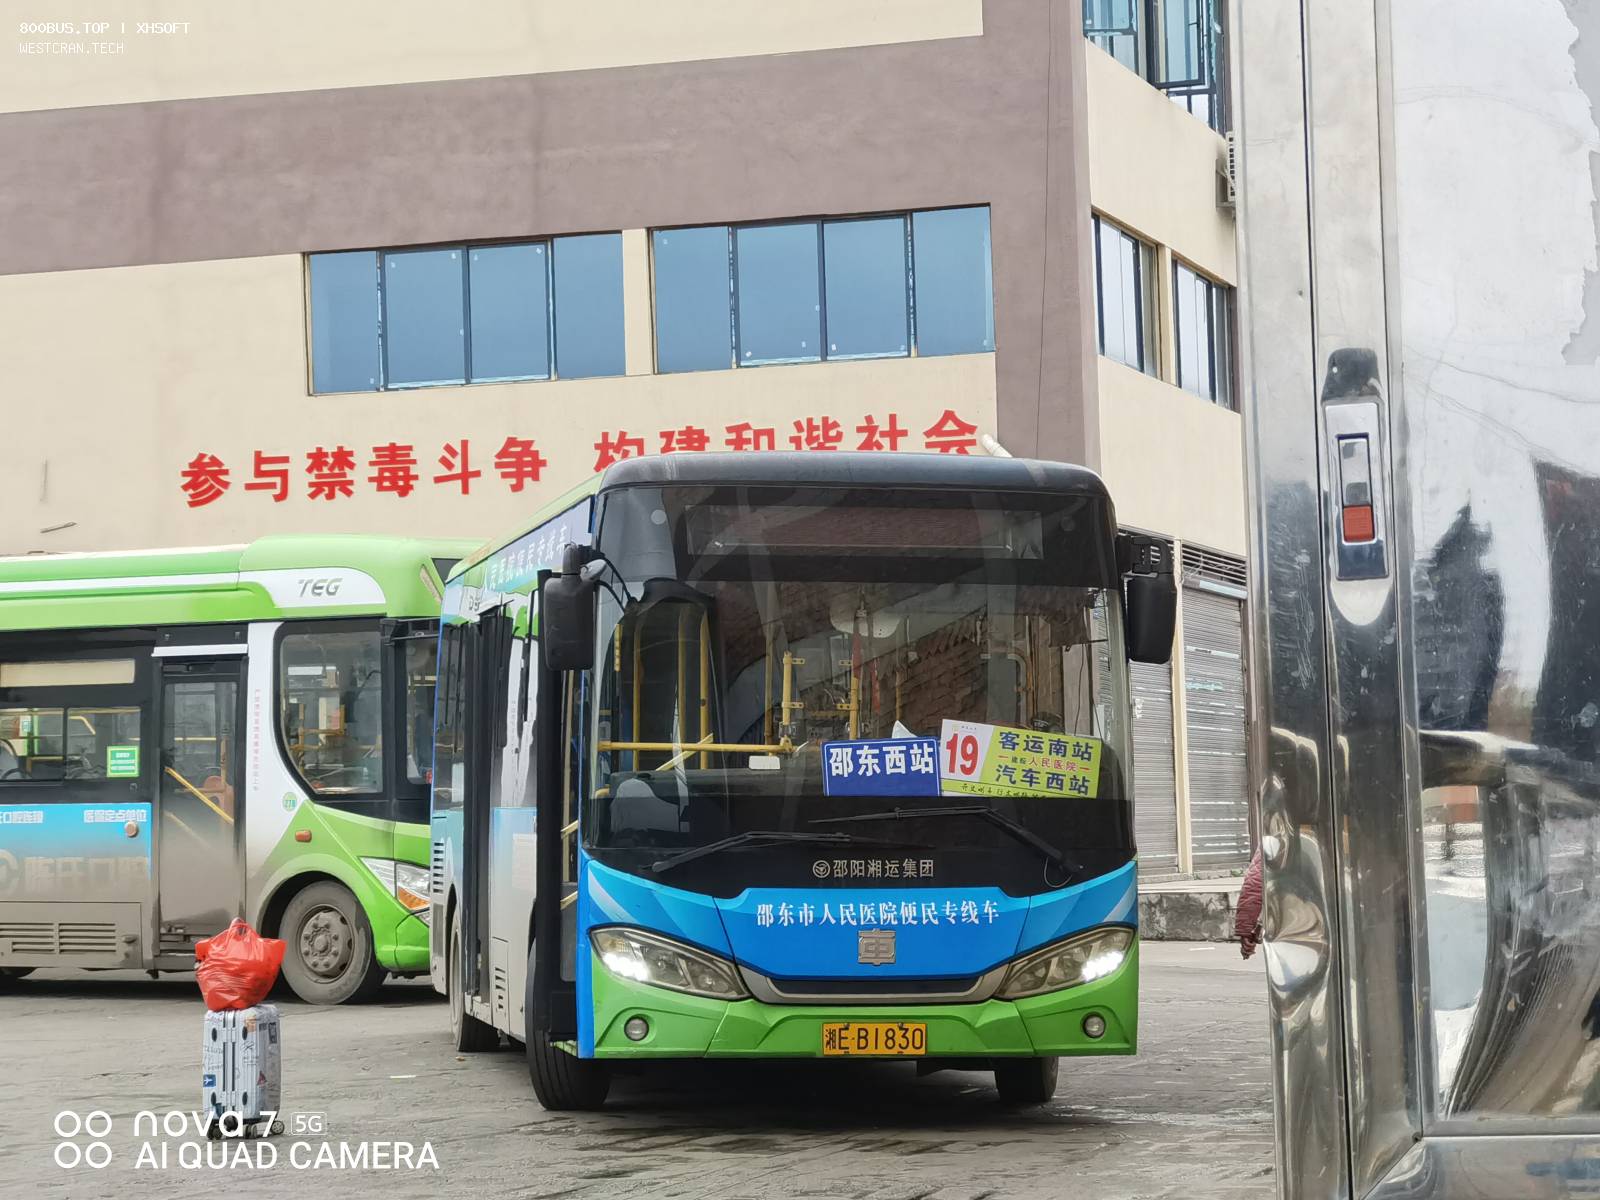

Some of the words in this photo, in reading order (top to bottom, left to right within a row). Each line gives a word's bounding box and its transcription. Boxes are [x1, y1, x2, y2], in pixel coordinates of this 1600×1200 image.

[181, 436, 548, 508] 参与禁毒斗争
[298, 578, 343, 597] TEG
[829, 742, 935, 777] 邵东西站
[946, 733, 979, 775] 19
[998, 731, 1093, 761] 客运南站
[995, 764, 1090, 796] 汽车西站
[833, 858, 934, 878] 邵阳湘运集团
[756, 900, 1000, 928] 邵东市人民医院便民专线车
